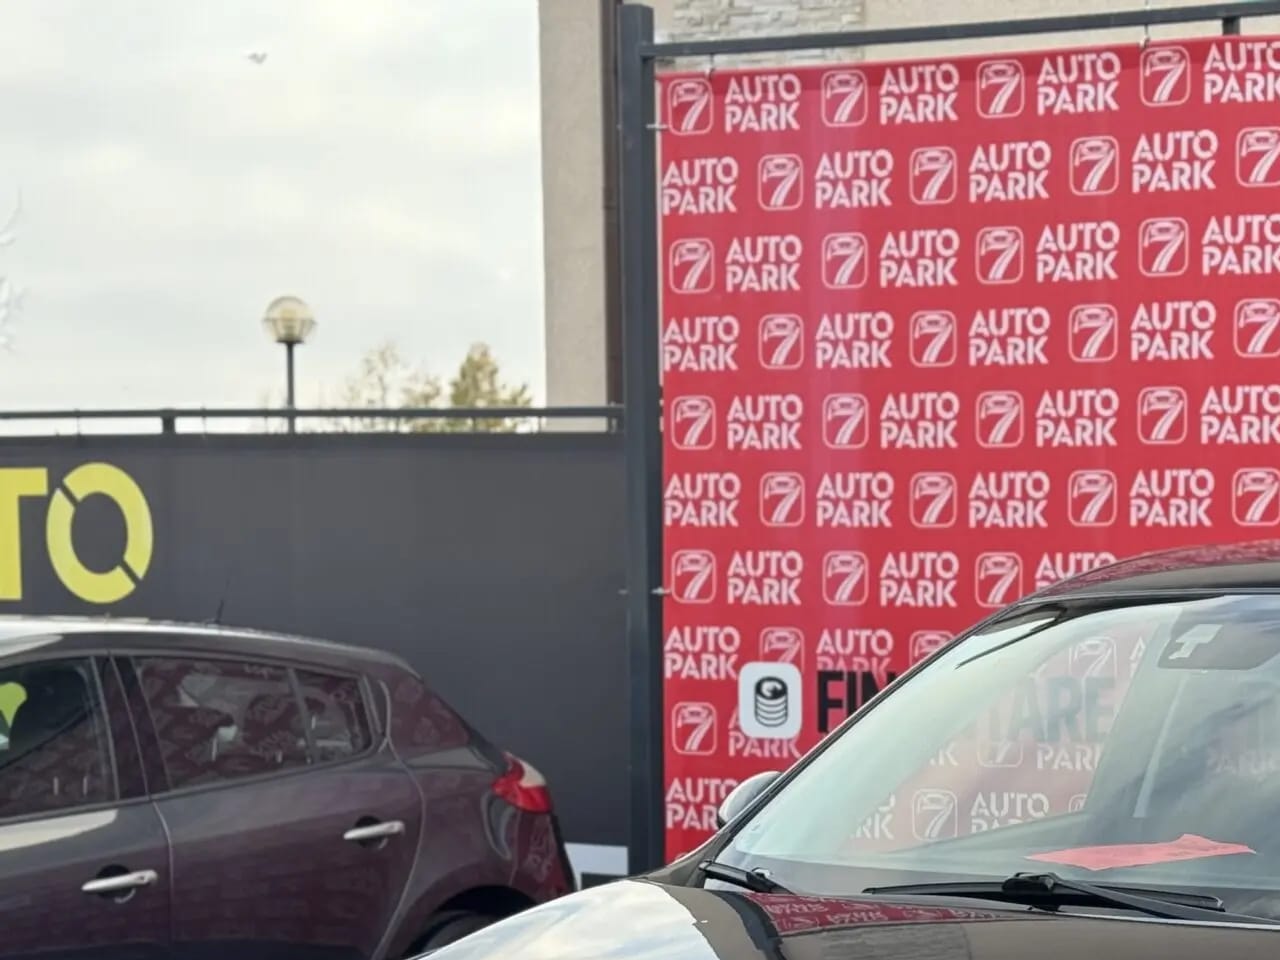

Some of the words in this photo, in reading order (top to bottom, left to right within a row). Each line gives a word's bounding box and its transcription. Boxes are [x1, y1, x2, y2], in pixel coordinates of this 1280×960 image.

[880, 64, 959, 95] AUTO
[1037, 52, 1120, 85] AUTO
[725, 74, 801, 106] AUTO
[1038, 81, 1118, 115] PARK
[726, 102, 799, 132] PARK
[880, 93, 957, 124] PARK
[969, 141, 1051, 173] AUTO
[1132, 130, 1218, 163] AUTO
[661, 156, 738, 188] AUTO
[815, 149, 893, 180] AUTO
[1133, 160, 1215, 192] PARK
[661, 184, 736, 217] PARK
[816, 178, 891, 208] PARK
[970, 170, 1048, 202] PARK
[726, 235, 802, 263] AUTO
[880, 229, 959, 259] AUTO
[1037, 221, 1120, 252] AUTO
[727, 263, 800, 291] PARK
[880, 257, 957, 287] PARK
[1037, 251, 1117, 282] PARK
[662, 314, 739, 347] AUTO
[816, 312, 893, 344] AUTO
[969, 307, 1050, 337] AUTO
[1131, 300, 1216, 332] AUTO
[662, 340, 737, 374] PARK
[816, 337, 891, 368] PARK
[970, 336, 1048, 365] PARK
[1132, 330, 1213, 360] PARK
[728, 394, 803, 422] AUTO
[880, 392, 959, 420] AUTO
[1036, 389, 1119, 418] AUTO
[728, 422, 801, 449] PARK
[881, 420, 957, 448] PARK
[1037, 418, 1116, 446] PARK
[664, 473, 740, 503] AUTO
[817, 472, 893, 499] AUTO
[969, 471, 1050, 499] AUTO
[1130, 469, 1214, 499] AUTO
[664, 497, 738, 526] PARK
[817, 500, 891, 527] PARK
[969, 500, 1047, 528] PARK
[1130, 498, 1211, 526] PARK
[728, 551, 803, 577] AUTO
[880, 552, 959, 579] AUTO
[728, 578, 801, 604] PARK
[881, 579, 956, 607] PARK
[664, 626, 740, 653] AUTO
[816, 629, 893, 656] AUTO
[664, 651, 738, 679] PARK
[971, 792, 1049, 819] AUTO
